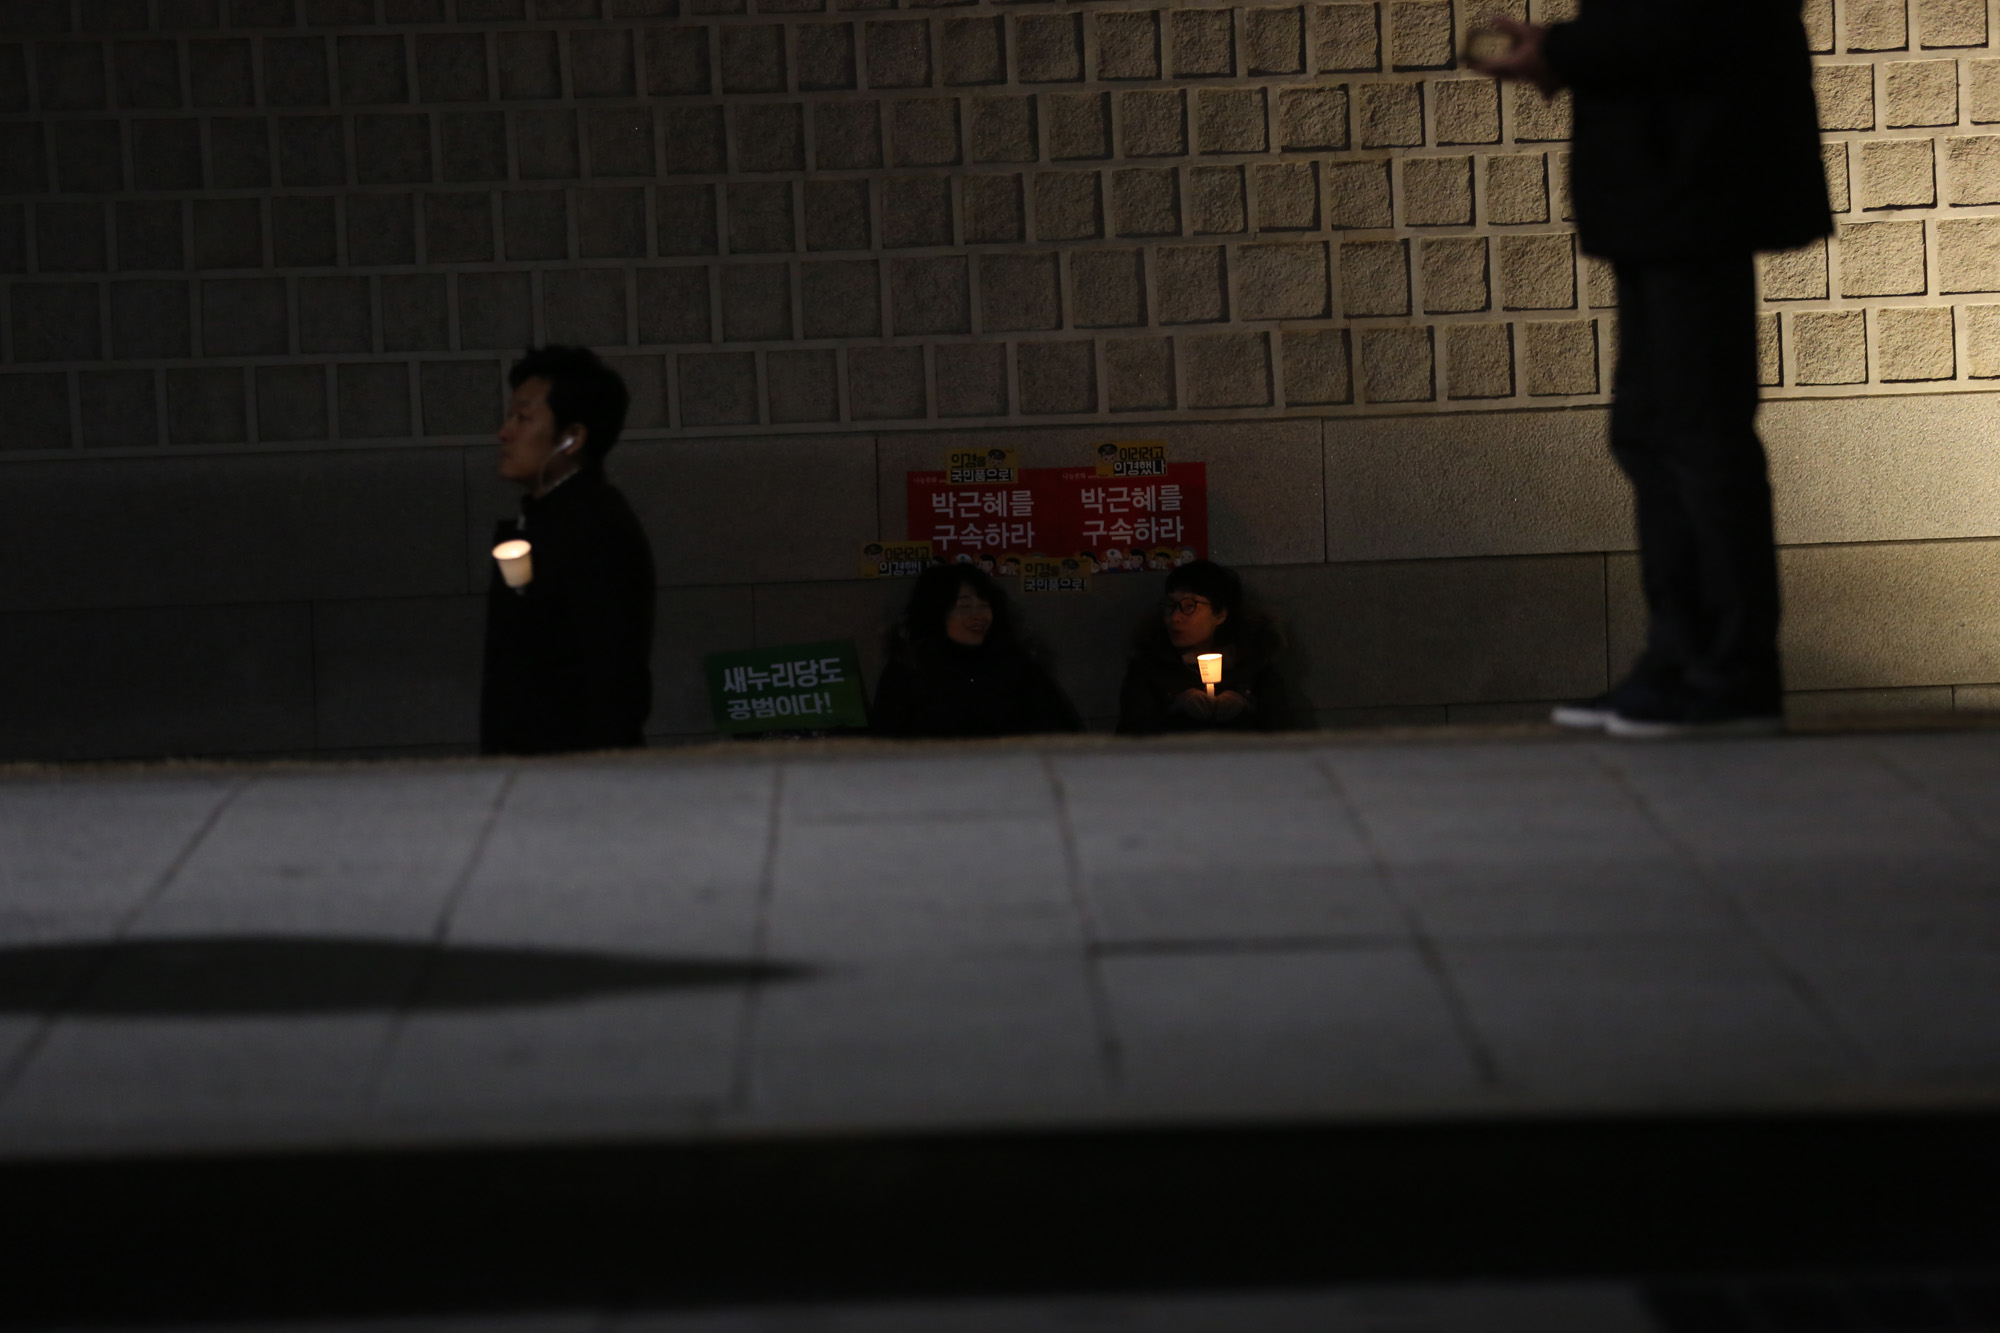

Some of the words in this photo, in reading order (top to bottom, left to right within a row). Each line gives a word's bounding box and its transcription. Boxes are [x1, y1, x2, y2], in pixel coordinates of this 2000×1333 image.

[1114, 460, 1166, 476] 의경했나
[1119, 446, 1164, 460] 이러려고
[931, 488, 1035, 519] 박근혜를
[1080, 484, 1184, 514] 박근혜를
[932, 520, 1036, 551] 구속하라
[1082, 515, 1185, 546] 구속하라
[885, 547, 930, 561] 이러려고
[723, 657, 845, 693] 새누리당도
[727, 692, 833, 720] 공범이다!
